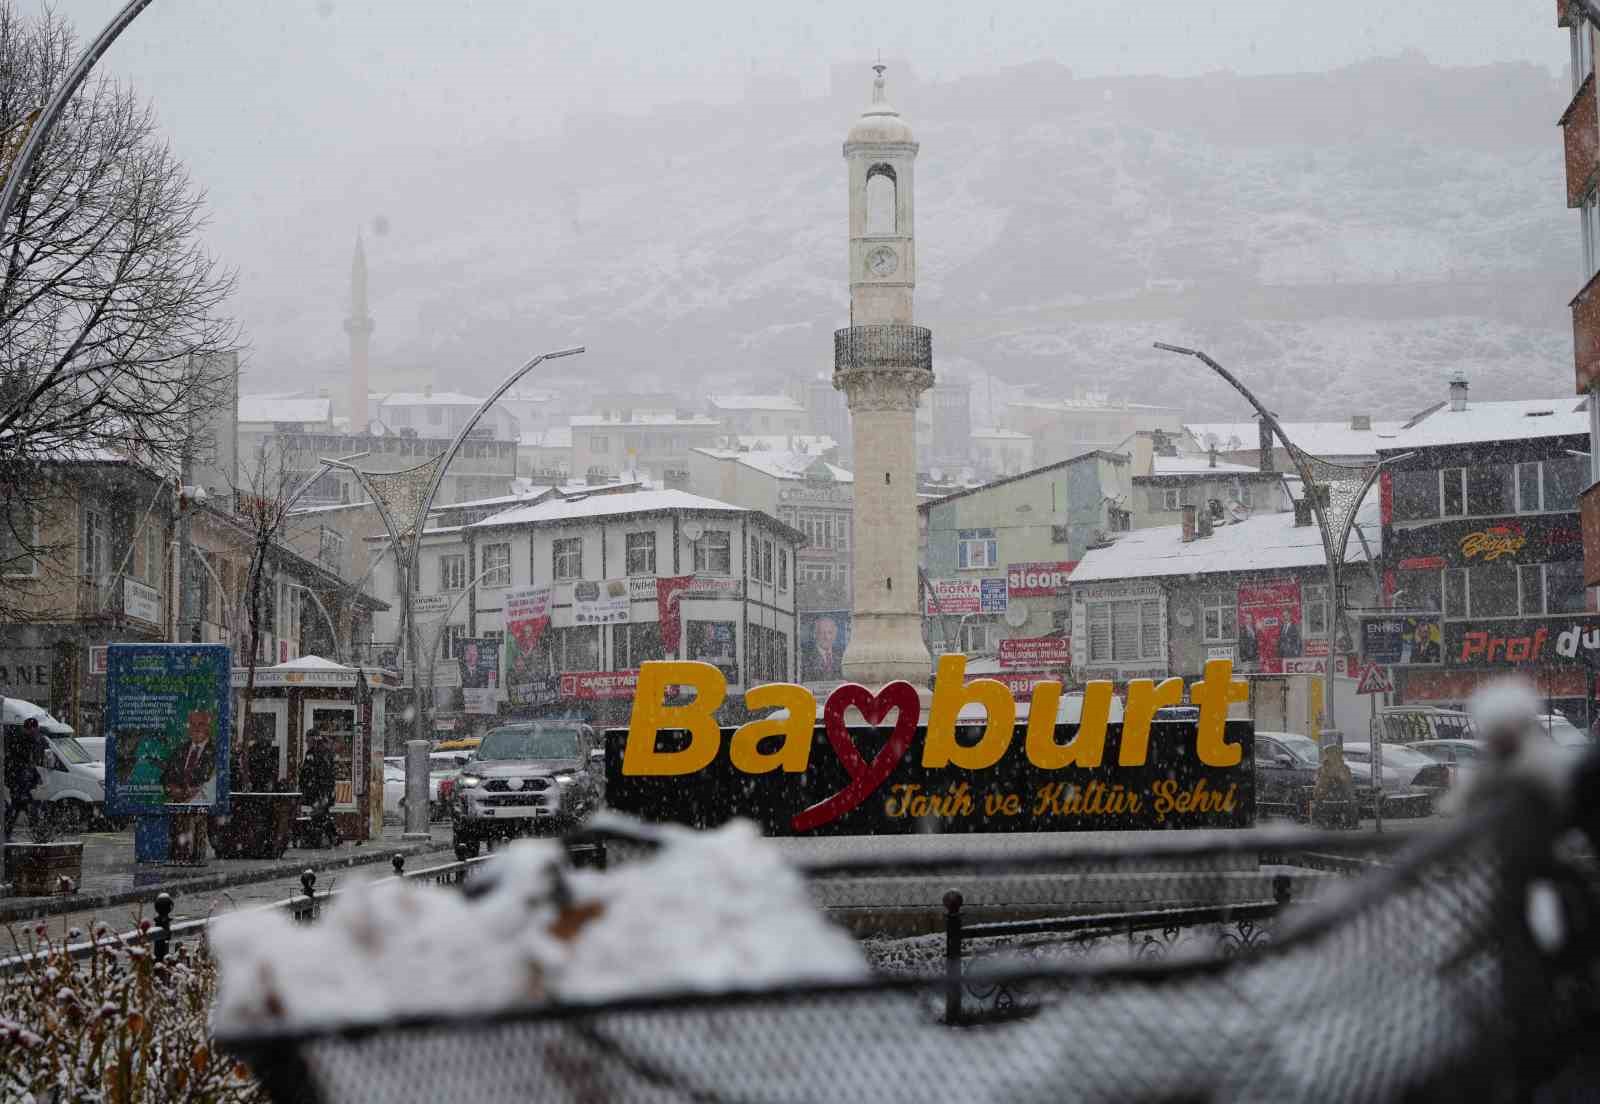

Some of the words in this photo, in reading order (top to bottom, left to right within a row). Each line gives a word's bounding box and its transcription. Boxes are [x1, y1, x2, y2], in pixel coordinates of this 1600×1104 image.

[885, 782, 974, 817] Tarih
[984, 792, 1021, 817] ve
[1033, 781, 1143, 817] Kültür
[1152, 778, 1238, 823] Şehri
